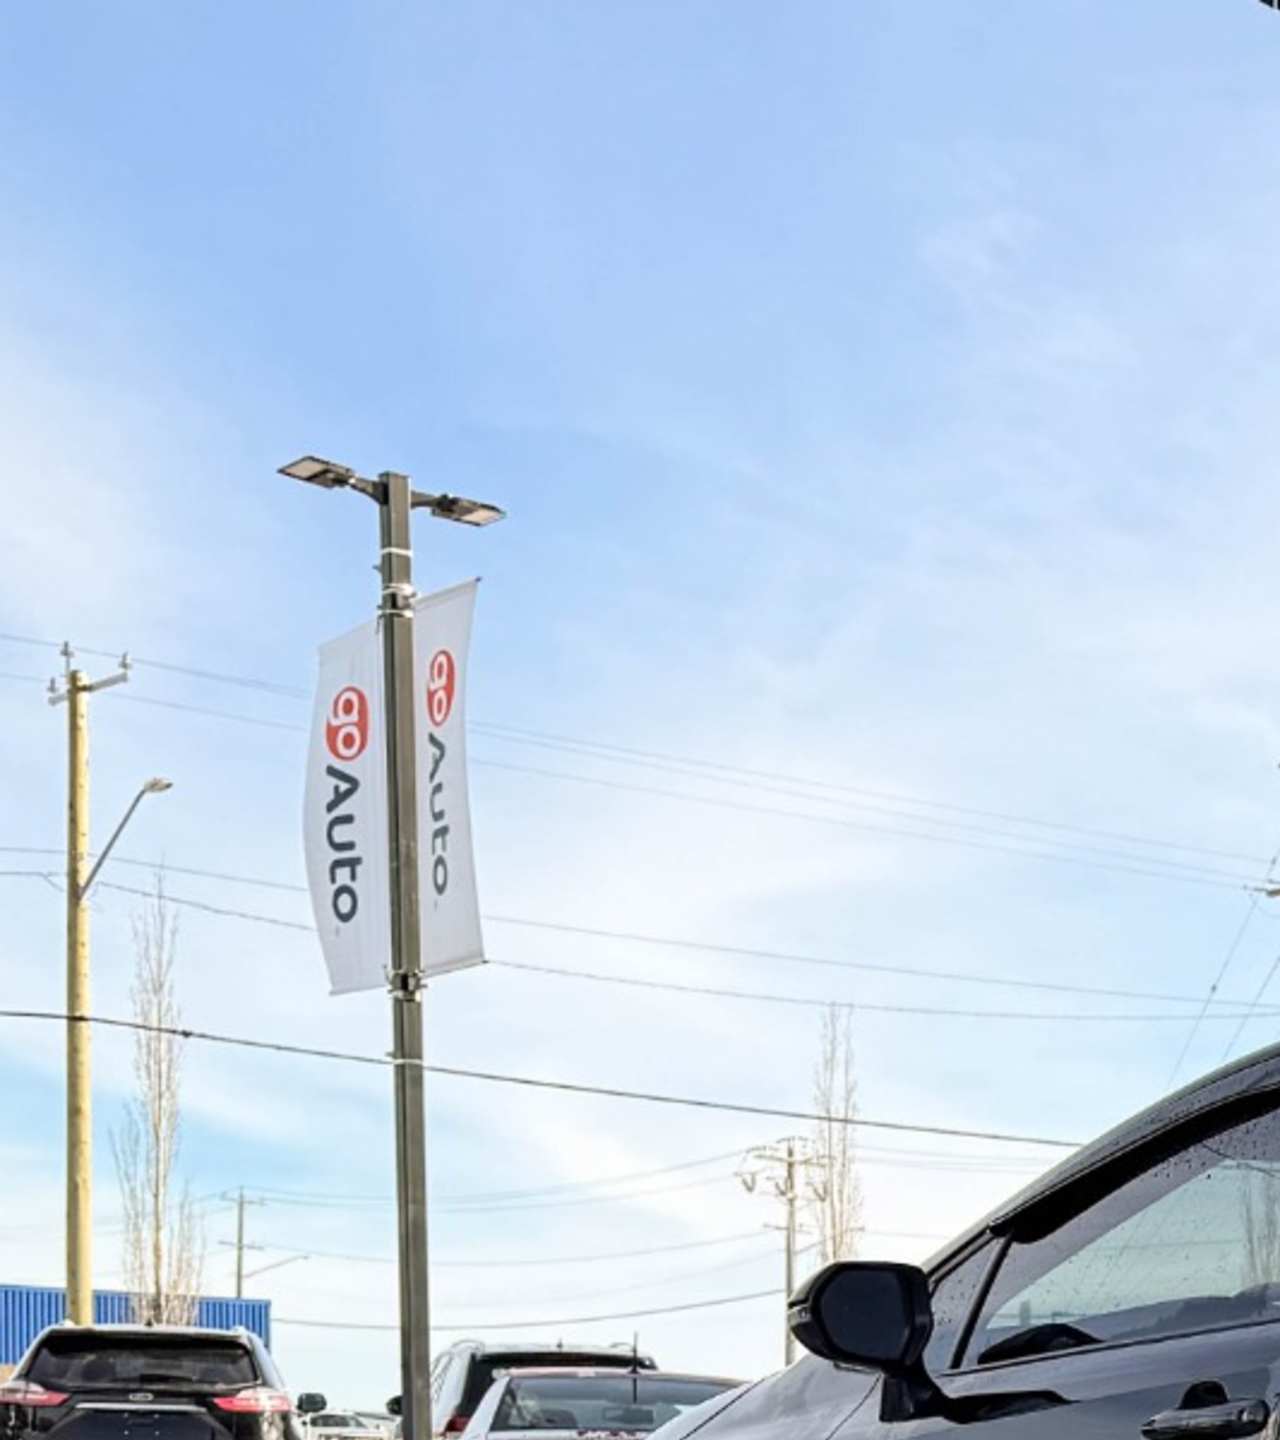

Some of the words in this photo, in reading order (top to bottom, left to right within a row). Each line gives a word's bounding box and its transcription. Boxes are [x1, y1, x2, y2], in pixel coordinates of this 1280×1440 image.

[327, 688, 367, 758] go
[428, 652, 454, 725] go
[326, 764, 363, 923] Auto
[427, 734, 450, 896] Auto
